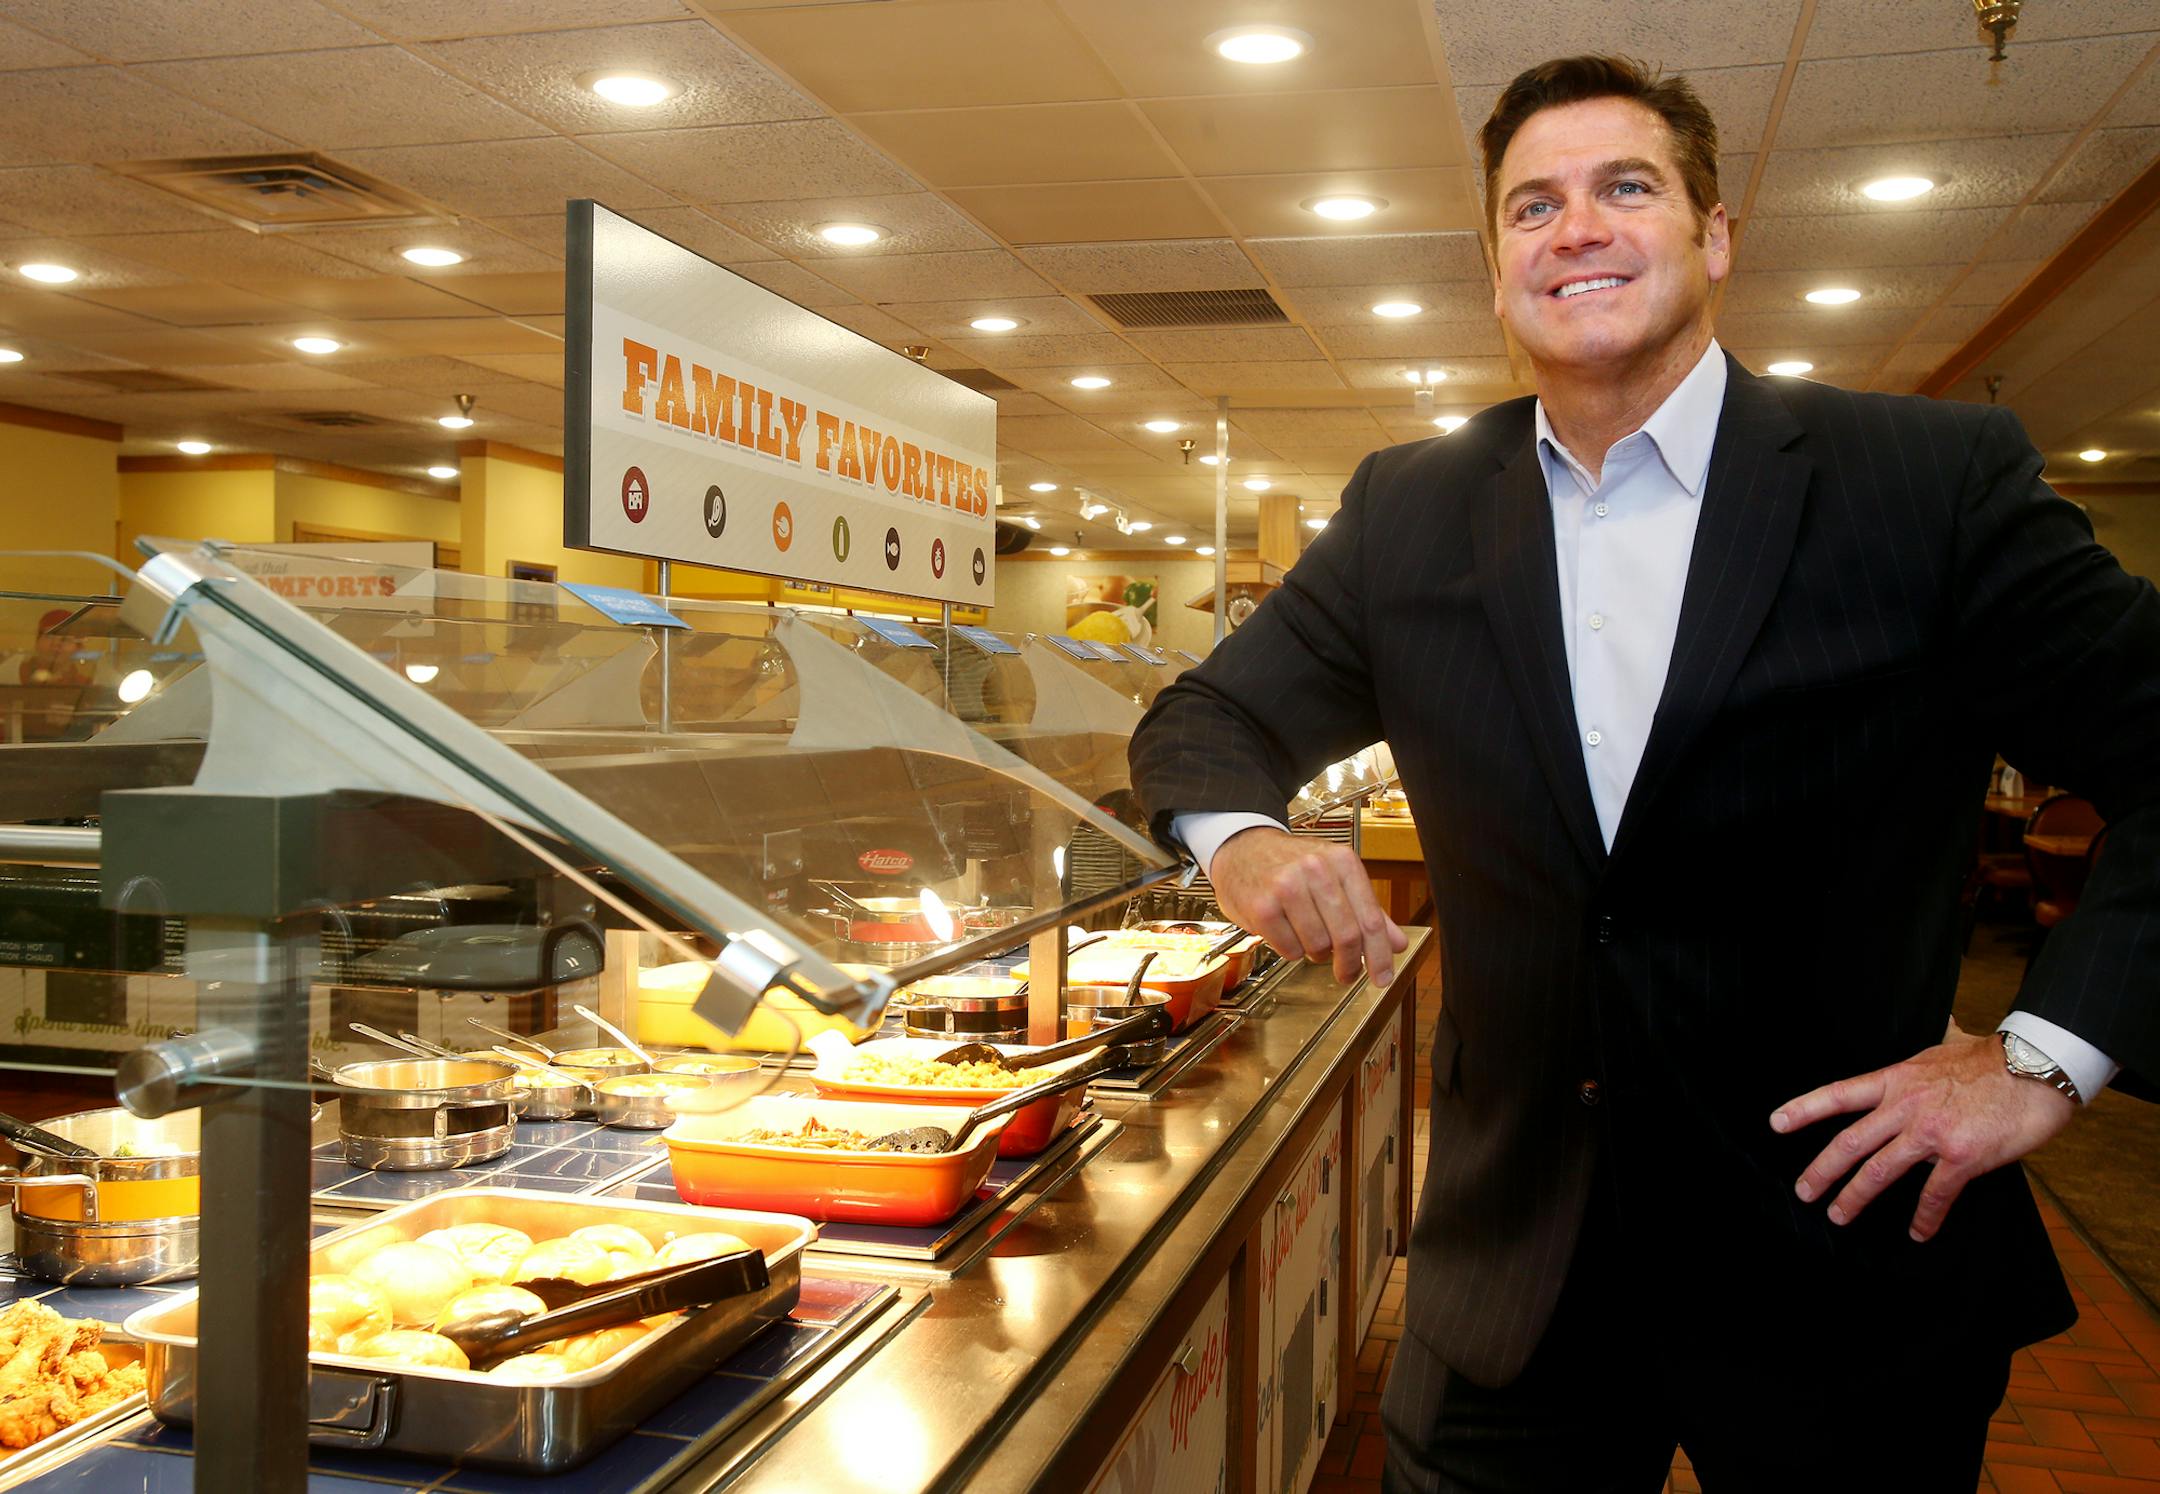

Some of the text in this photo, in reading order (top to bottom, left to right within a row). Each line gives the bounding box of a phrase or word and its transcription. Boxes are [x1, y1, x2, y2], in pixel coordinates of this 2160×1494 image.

[622, 336, 989, 519] FAMILY FAVORITES
[262, 562, 289, 575] that
[256, 575, 396, 598] MFORTS
[860, 853, 910, 869] Hatco
[0, 942, 20, 952] TION
[26, 943, 44, 952] HOT
